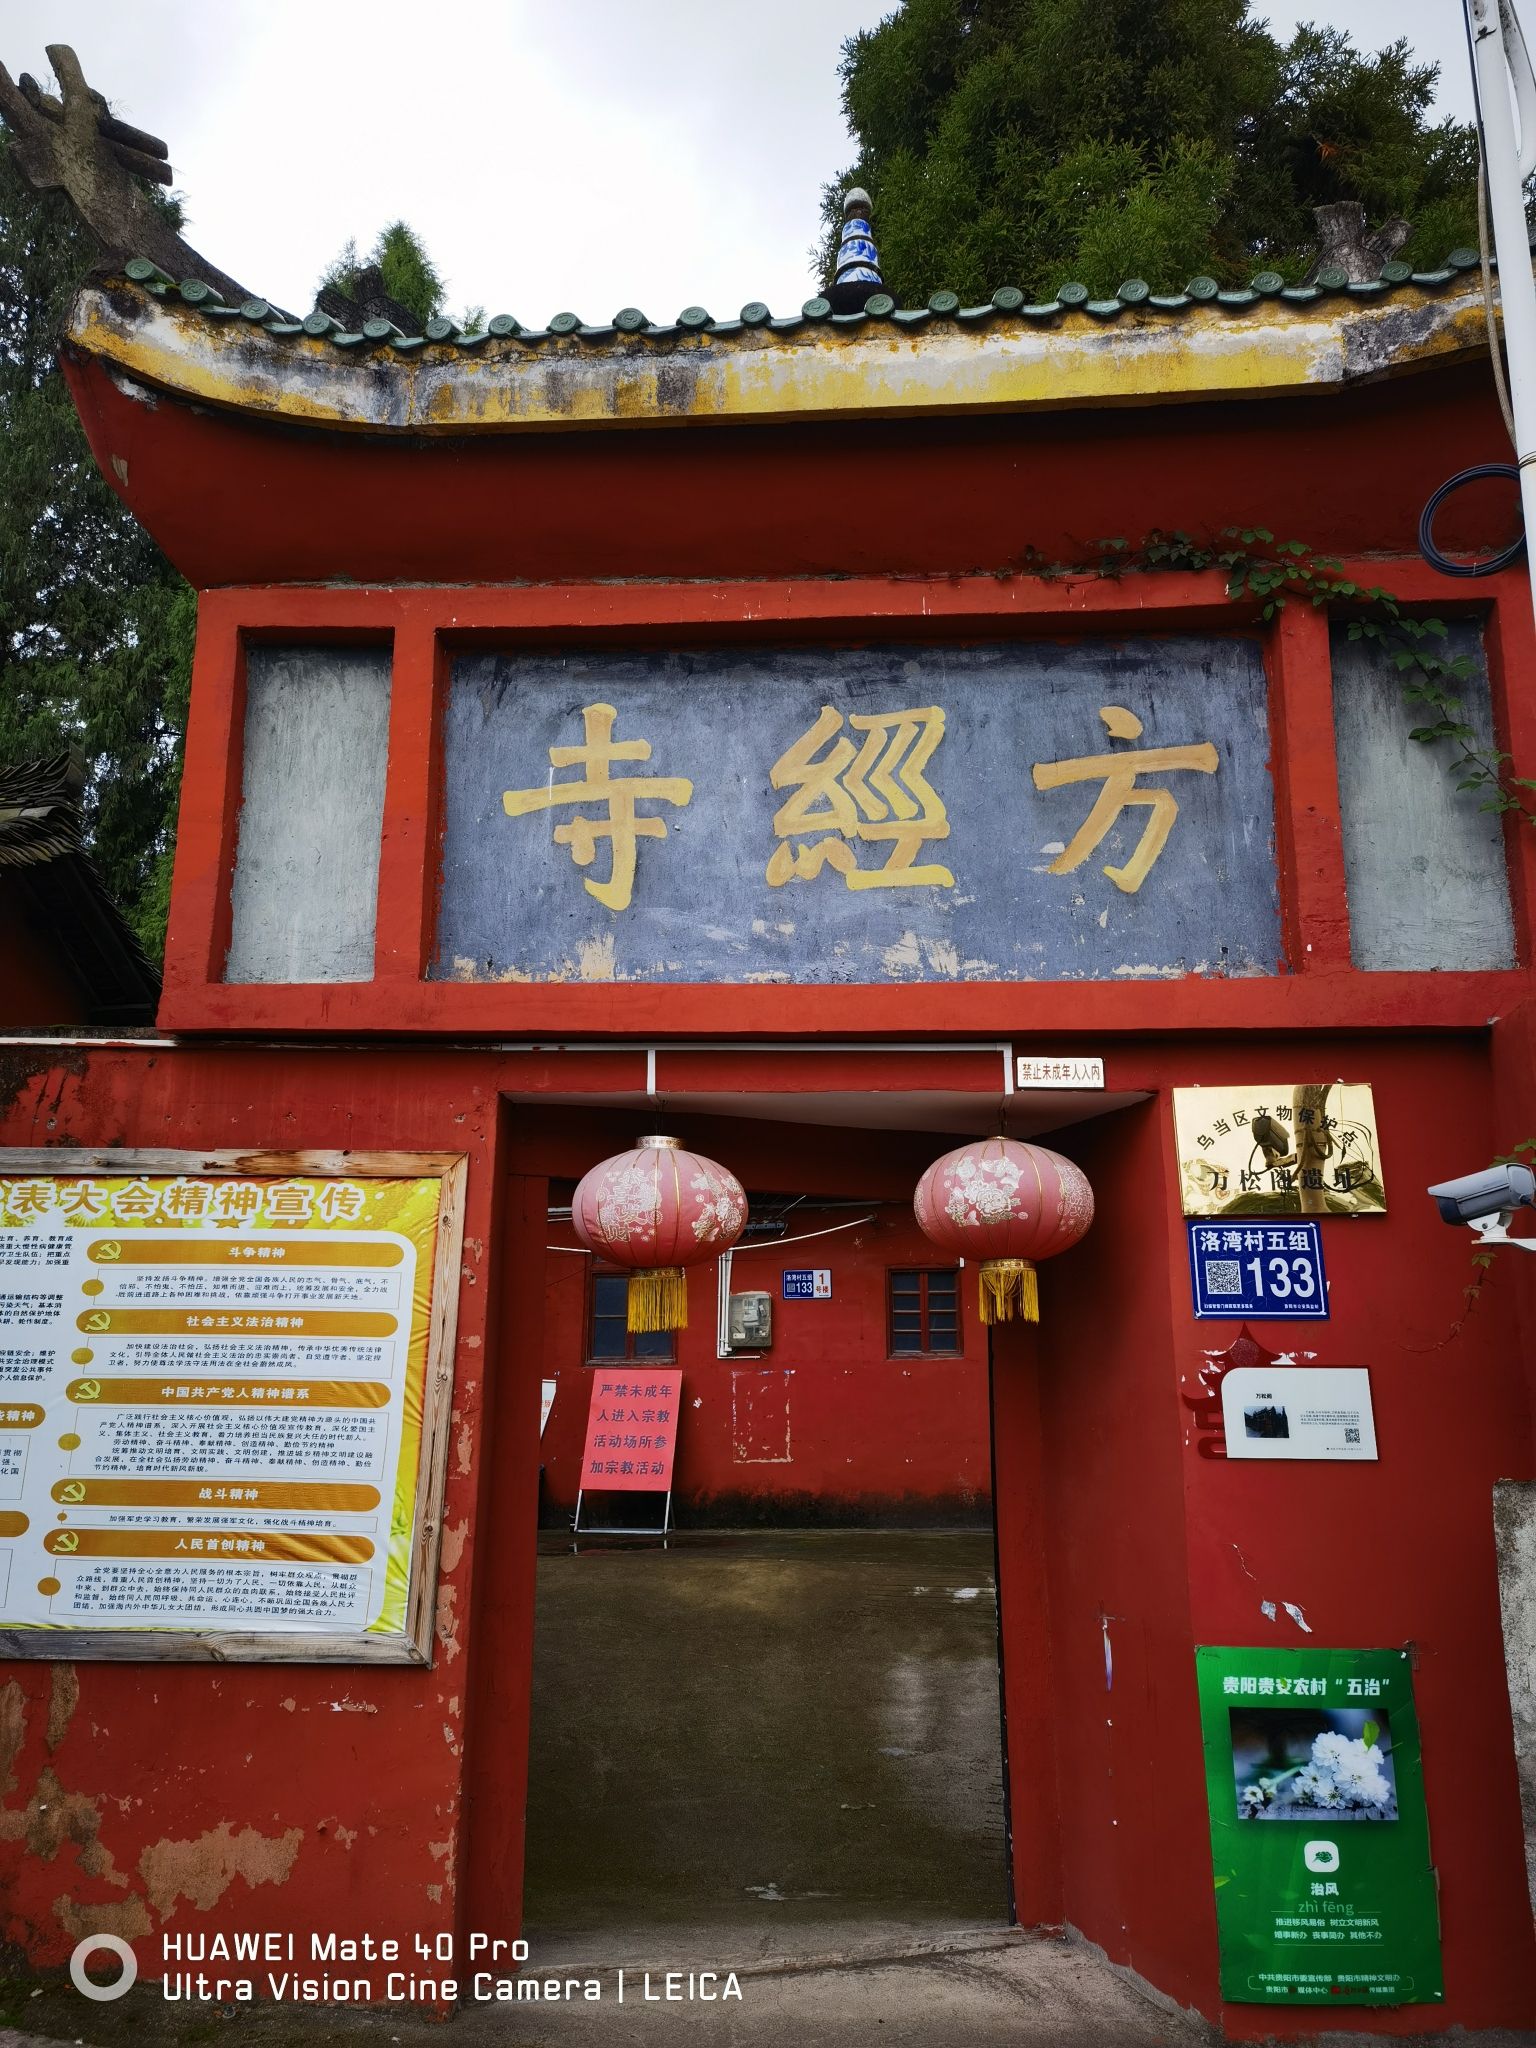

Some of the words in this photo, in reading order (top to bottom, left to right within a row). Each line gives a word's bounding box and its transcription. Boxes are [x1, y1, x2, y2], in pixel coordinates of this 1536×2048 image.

[1023, 1063, 1100, 1080] 禁止未成年人入内
[1196, 1105, 1359, 1150] 乌当区文物保护点
[12, 1184, 361, 1218] 表大会精神宣传
[1200, 1230, 1311, 1252] 洛湾村五组
[228, 1246, 286, 1259] 斗争精神
[819, 1273, 824, 1285] 1
[1247, 1257, 1315, 1298] 133
[796, 1282, 812, 1293] 133
[186, 1315, 305, 1328] 社会主义法治精神
[161, 1386, 310, 1400] 中国共产党人精神谱系
[600, 1384, 672, 1398] 严禁未成年
[596, 1408, 671, 1423] 人进入宗教
[594, 1434, 667, 1449] 活动场所参
[590, 1460, 664, 1475] 加宗教活动
[198, 1487, 259, 1501] 战斗精神
[174, 1537, 265, 1552] 人民首创精神
[1311, 1882, 1339, 1896] 治风
[1298, 1900, 1319, 1913] zhì
[1322, 1900, 1354, 1916] fēng
[1265, 1986, 1328, 1994] 贵阳市媒体中心
